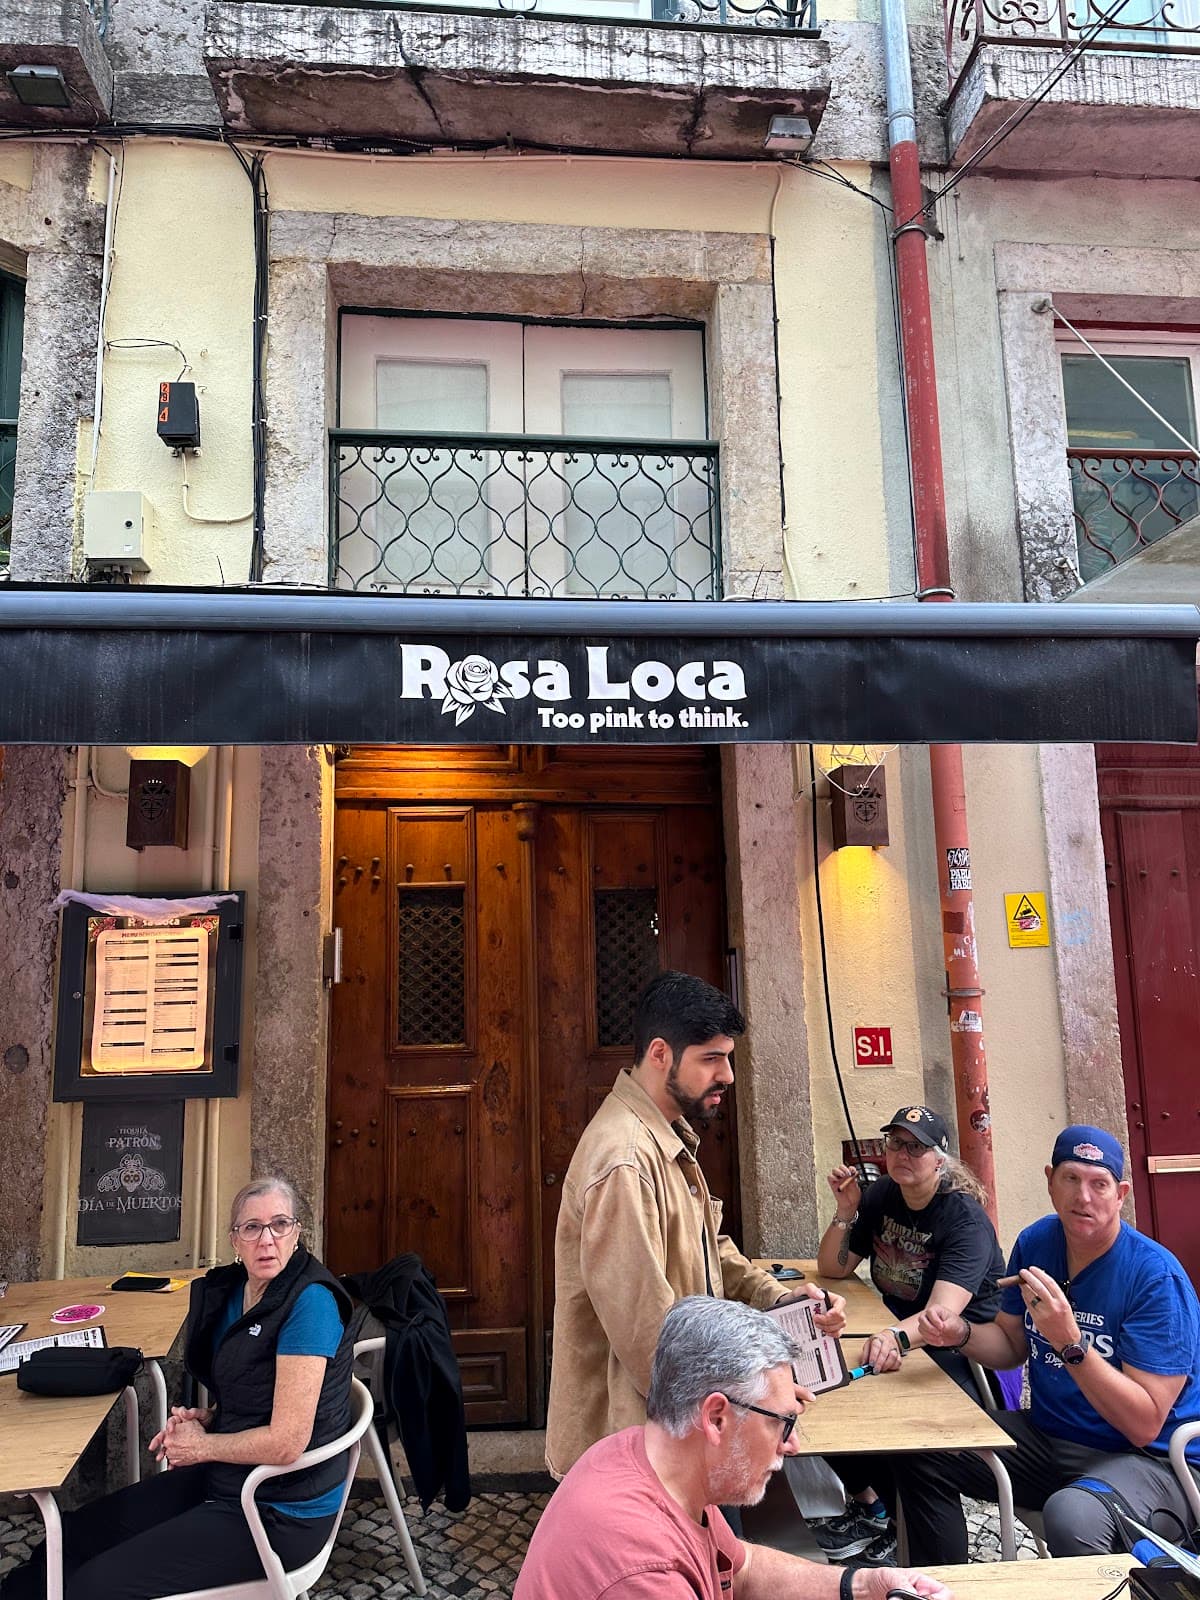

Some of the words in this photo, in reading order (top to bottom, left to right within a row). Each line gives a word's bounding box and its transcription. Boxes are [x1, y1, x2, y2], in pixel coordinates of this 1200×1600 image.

[400, 644, 572, 702] Rosa
[586, 646, 748, 702] Loca
[537, 707, 585, 729] Too
[590, 705, 645, 733] pink
[648, 708, 675, 729] to
[678, 706, 749, 729] think.
[857, 1035, 891, 1057] S.I.
[905, 1108, 923, 1123] 6
[109, 1134, 157, 1148] PATRÓN
[881, 1230, 896, 1245] &
[896, 1235, 926, 1255] Sons
[1073, 1311, 1105, 1327] ERIES
